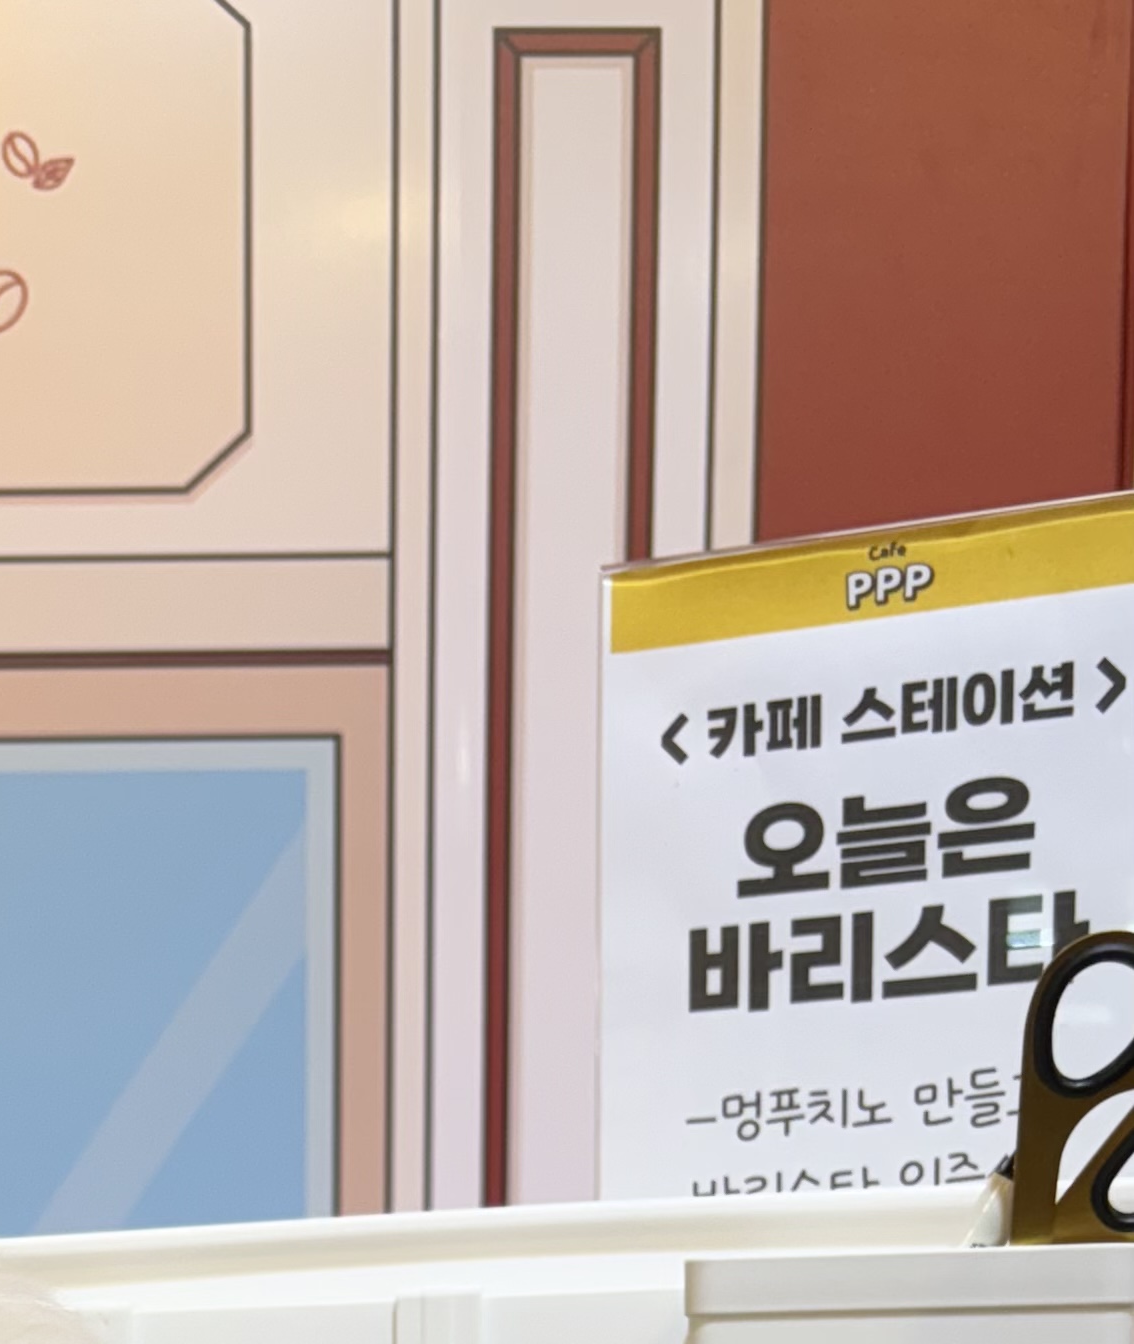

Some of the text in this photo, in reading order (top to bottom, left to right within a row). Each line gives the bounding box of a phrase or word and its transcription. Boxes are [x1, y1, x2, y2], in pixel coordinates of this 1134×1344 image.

[846, 563, 934, 611] PPP
[868, 541, 906, 561] Cafe
[707, 693, 822, 758] 카페
[840, 660, 1075, 744] 스테이션
[737, 775, 1036, 898] 오늘은
[688, 889, 1091, 1013] 바리스타
[913, 1066, 1021, 1128] 만들
